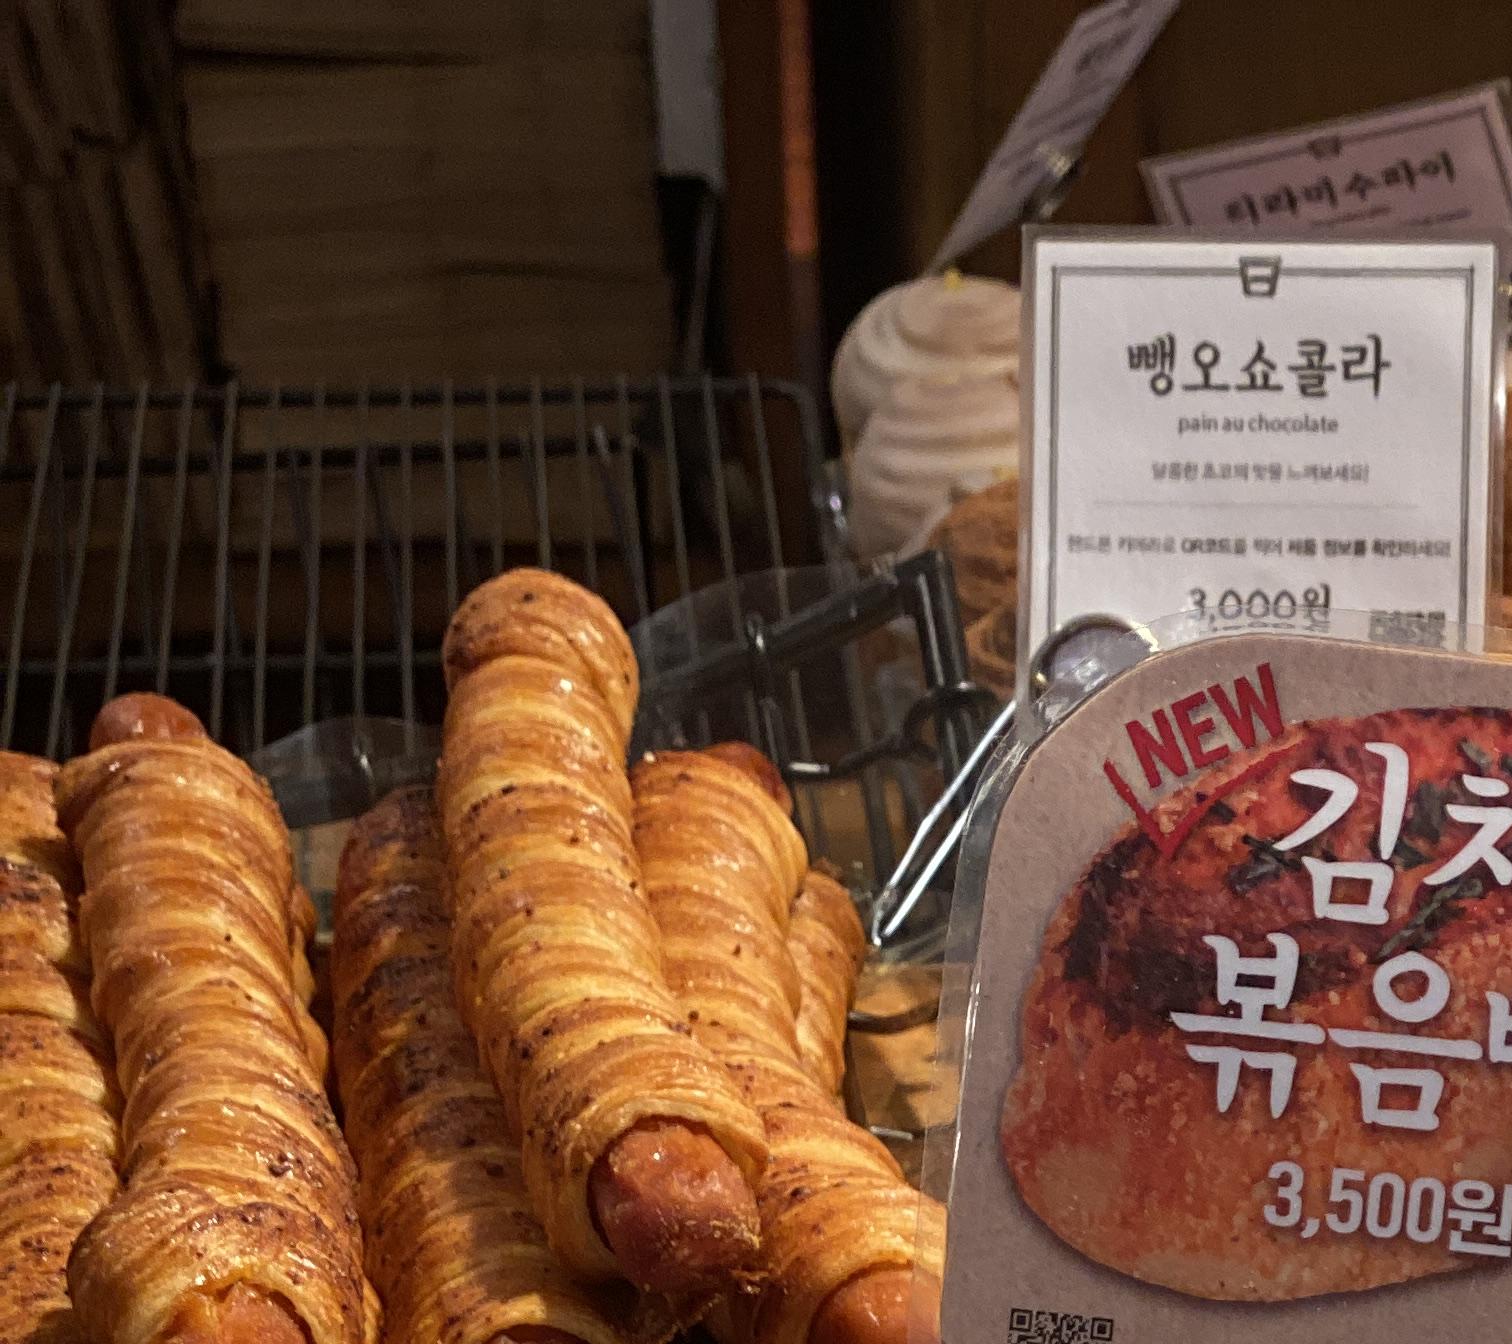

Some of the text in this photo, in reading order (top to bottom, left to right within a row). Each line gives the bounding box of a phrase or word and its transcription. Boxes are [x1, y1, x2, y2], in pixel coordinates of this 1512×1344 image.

[1127, 332, 1392, 400] 뺑오쇼콜라
[1177, 411, 1339, 435] pain au chocolate
[1188, 582, 1331, 624] 3,000원
[1124, 662, 1284, 788] NEW
